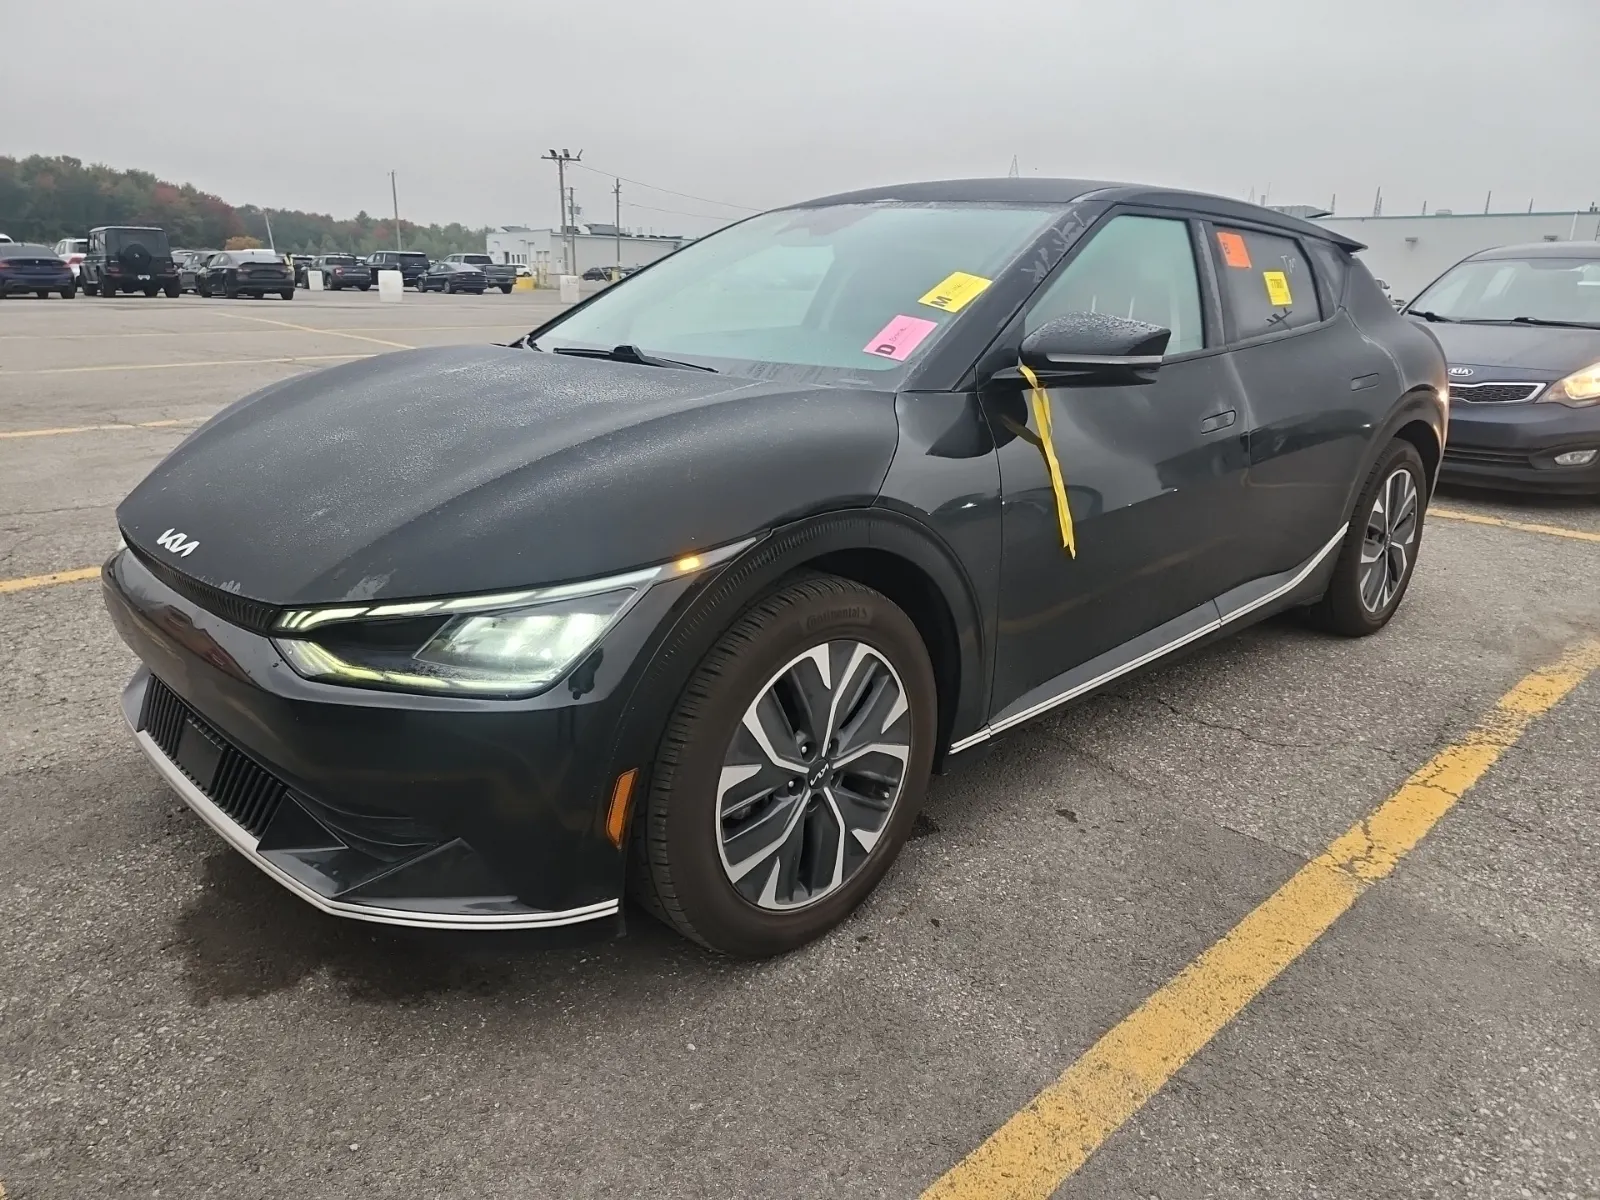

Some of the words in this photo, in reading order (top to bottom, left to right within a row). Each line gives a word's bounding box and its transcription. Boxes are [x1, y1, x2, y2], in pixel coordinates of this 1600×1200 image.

[930, 295, 953, 308] M
[874, 343, 897, 355] D
[1450, 367, 1469, 375] KIA
[156, 527, 200, 558] KIA
[806, 606, 860, 630] Continental
